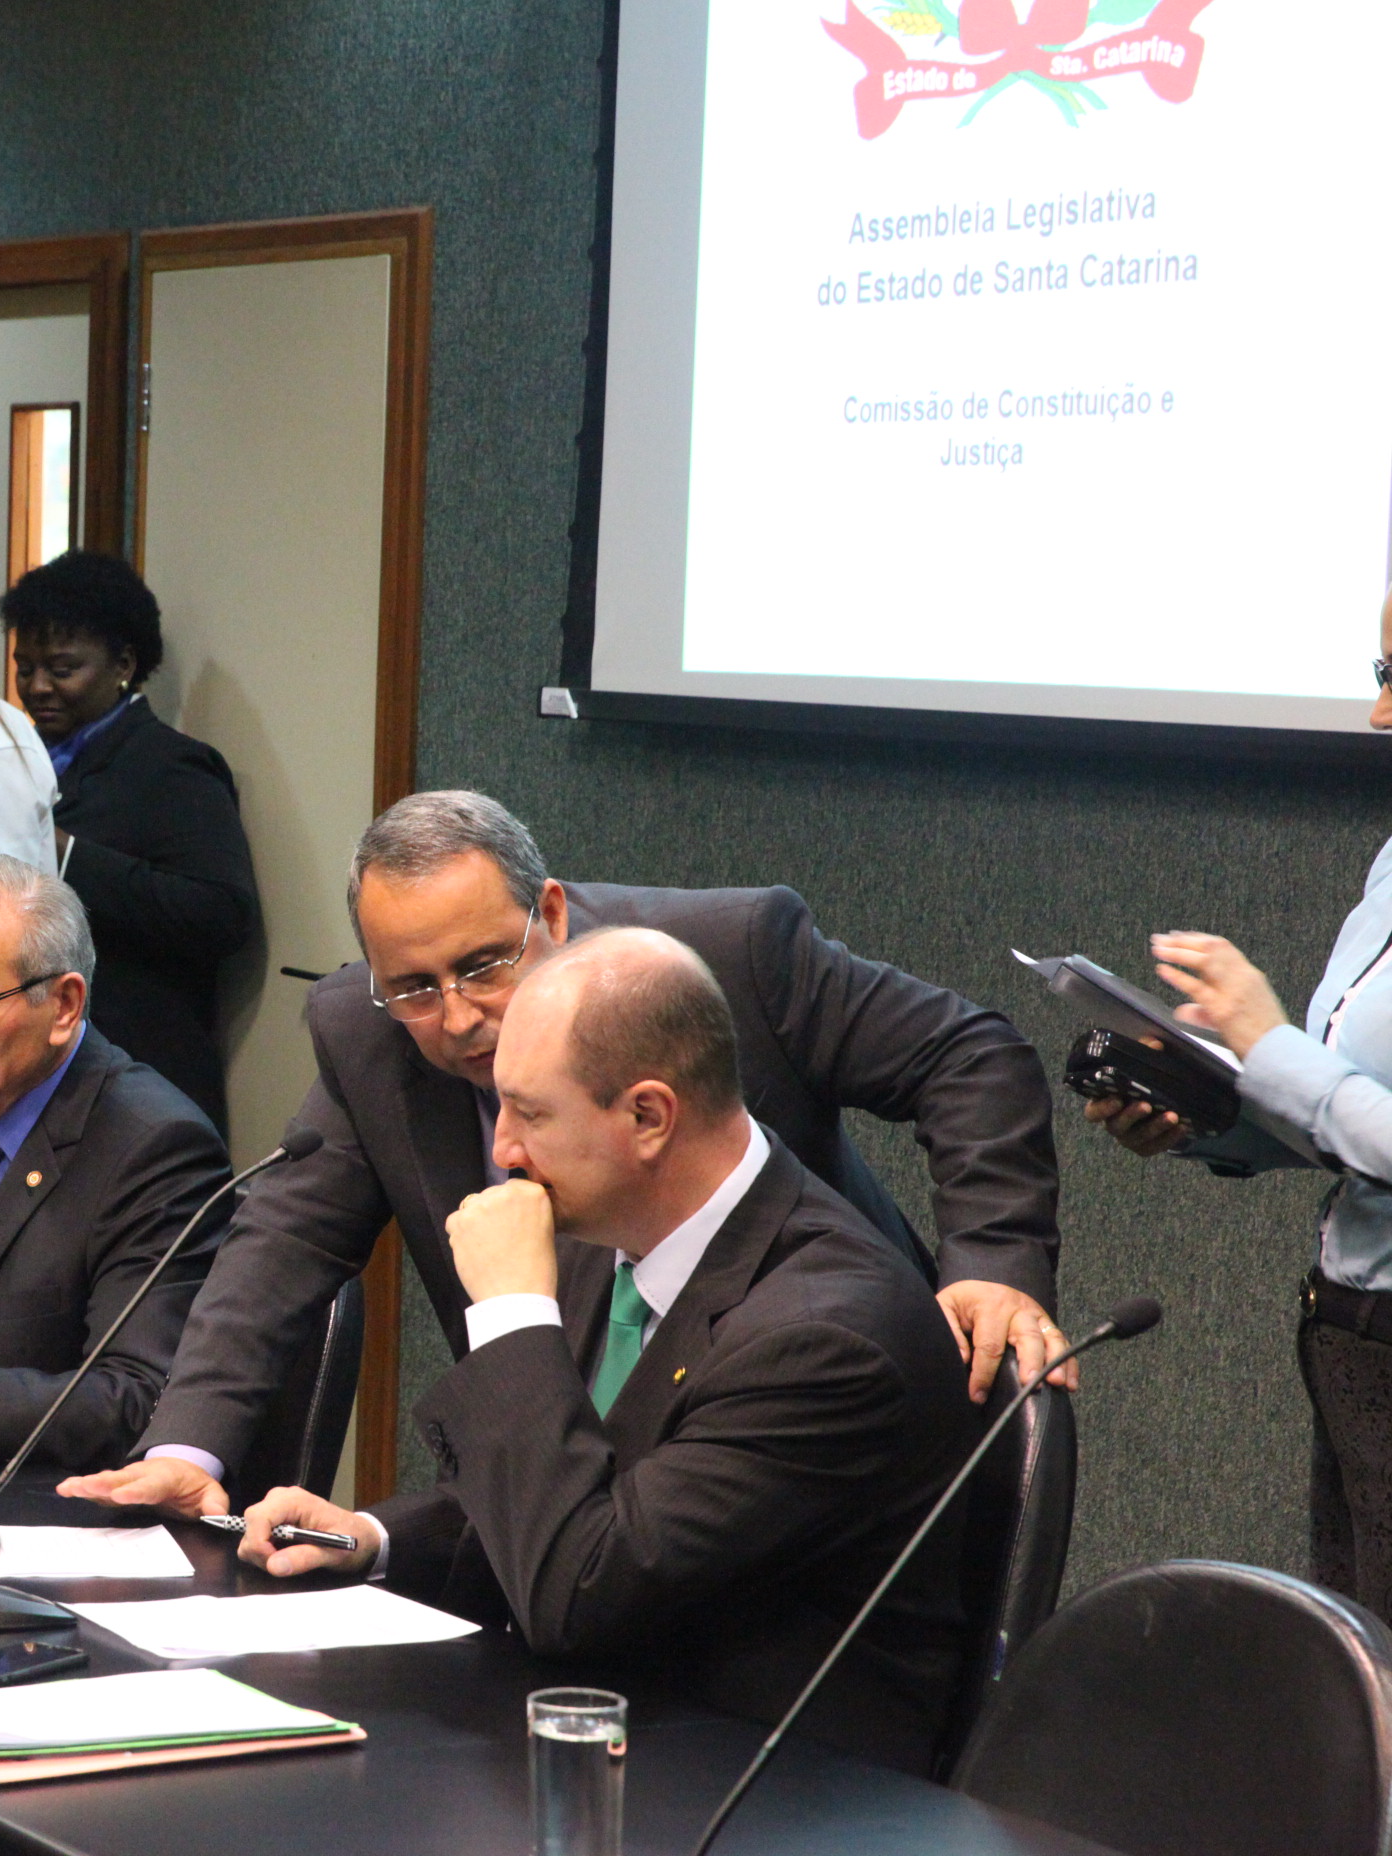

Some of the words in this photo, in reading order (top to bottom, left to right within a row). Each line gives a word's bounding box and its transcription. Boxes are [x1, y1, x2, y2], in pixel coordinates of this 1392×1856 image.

[883, 67, 948, 100] Estado
[952, 68, 976, 90] de
[1050, 55, 1088, 75] Sta.
[1093, 35, 1185, 69] Catarina
[849, 202, 995, 244] Assembleia
[1007, 188, 1156, 237] Legislativa
[818, 275, 847, 306] do
[857, 267, 943, 304] Estado
[953, 264, 984, 296] de
[994, 259, 1068, 294] Santa
[1080, 249, 1198, 288] Catarina
[844, 391, 954, 423] Comissão
[963, 392, 989, 419] de
[998, 382, 1152, 422] Constituição
[1161, 391, 1174, 412] e
[941, 437, 1023, 472] Justiça
